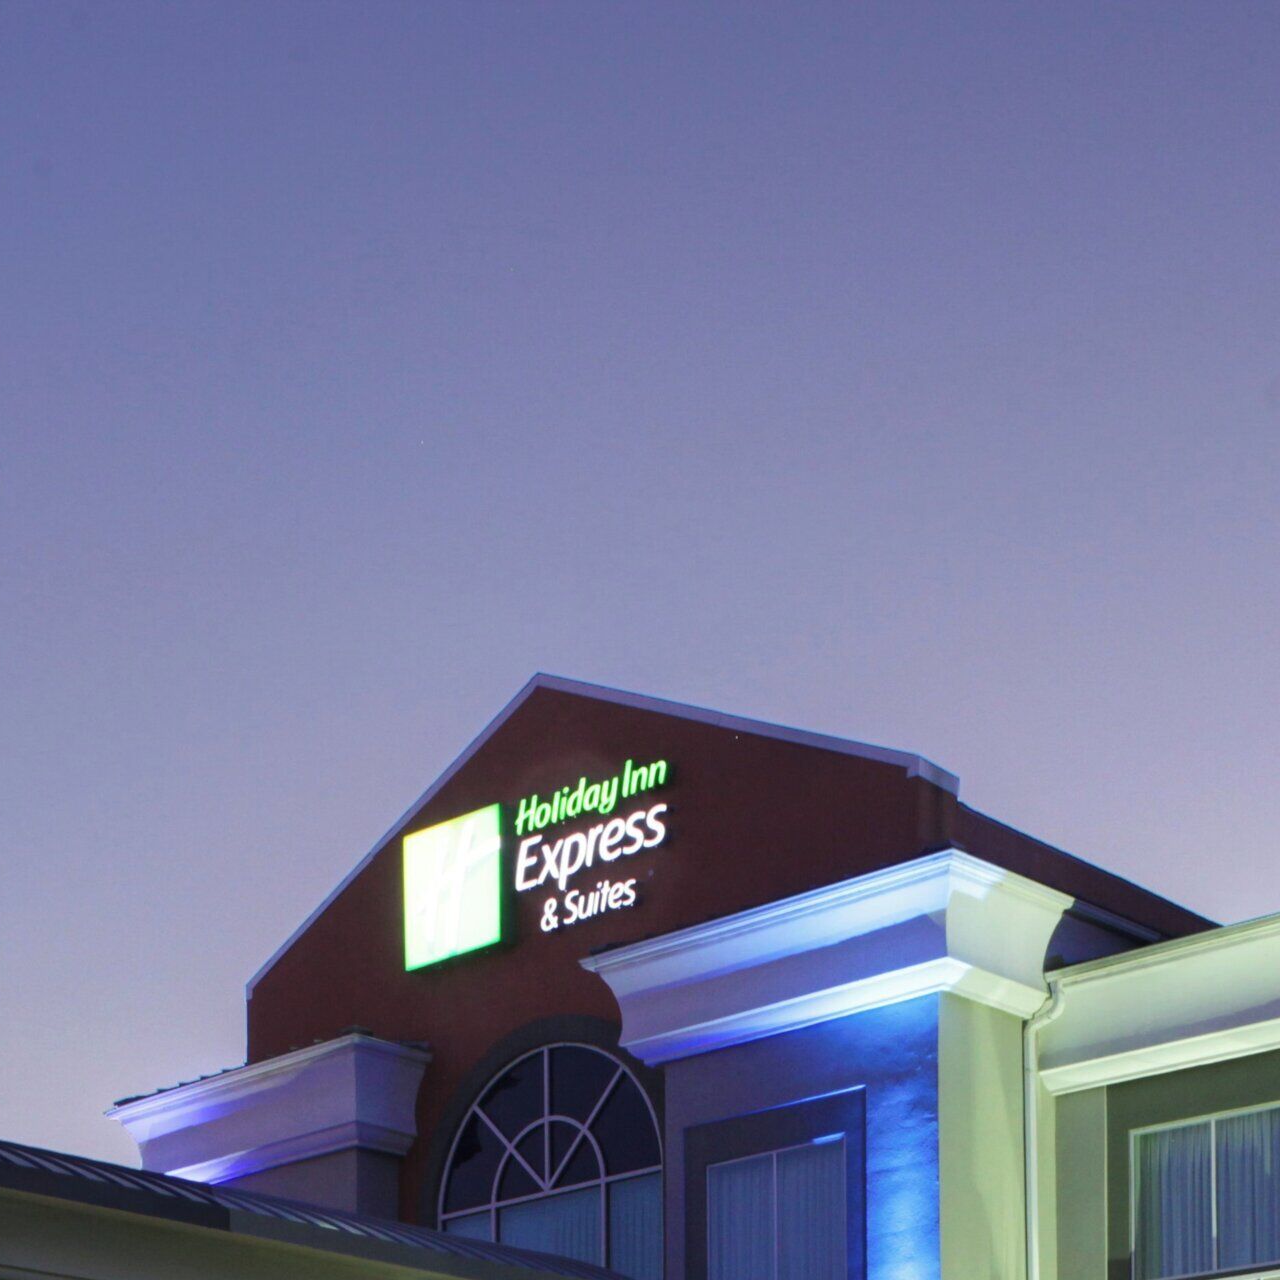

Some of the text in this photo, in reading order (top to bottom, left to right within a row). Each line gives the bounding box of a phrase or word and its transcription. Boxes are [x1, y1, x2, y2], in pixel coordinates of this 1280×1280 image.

[515, 759, 667, 836] Holiday Inn
[515, 803, 668, 891] Express
[540, 878, 636, 932] & Suites
